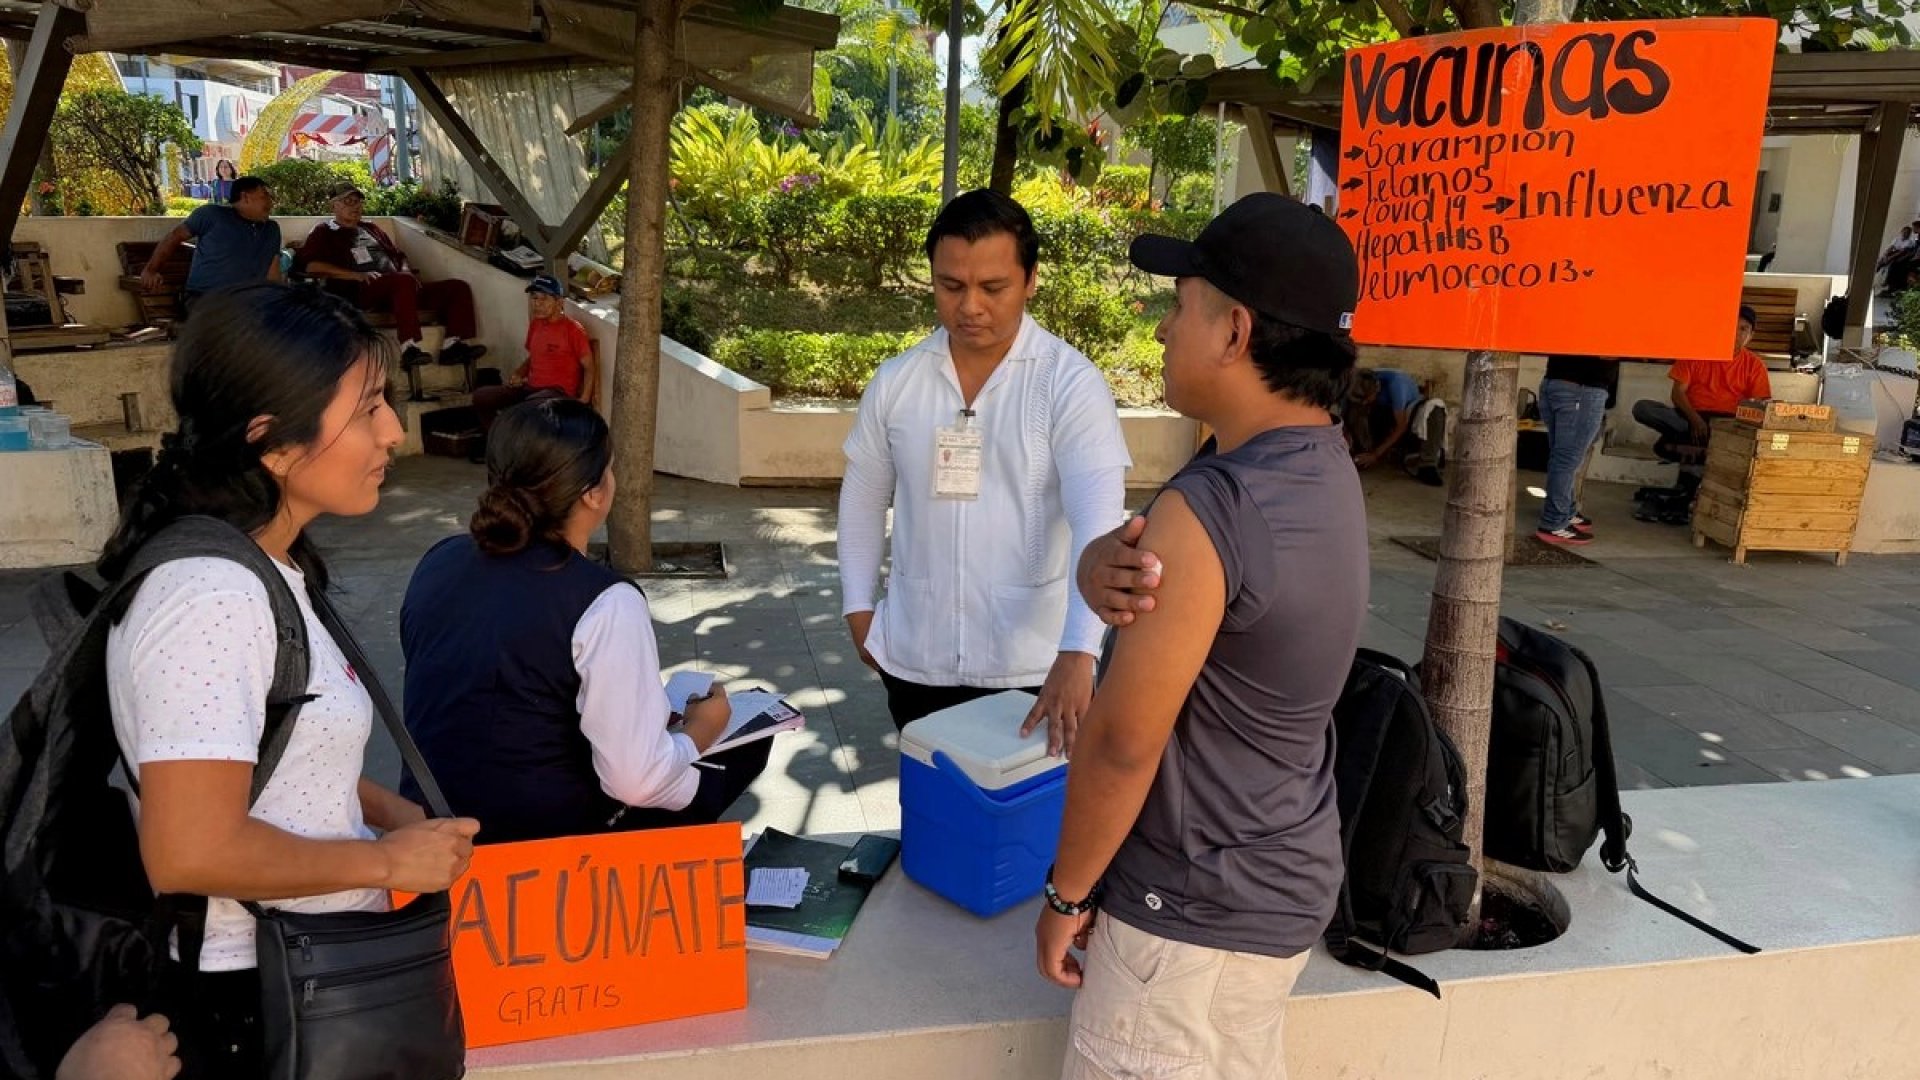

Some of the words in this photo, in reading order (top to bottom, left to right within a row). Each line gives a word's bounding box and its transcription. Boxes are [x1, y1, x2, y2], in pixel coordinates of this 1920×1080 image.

[1363, 188, 1436, 226] Covid
[1445, 194, 1466, 222] 19
[1504, 169, 1733, 220] Influenza
[1489, 224, 1511, 255] B
[1549, 259, 1579, 283] 13
[450, 854, 745, 968] ACÚNATE
[499, 985, 621, 1025] GRATIS
